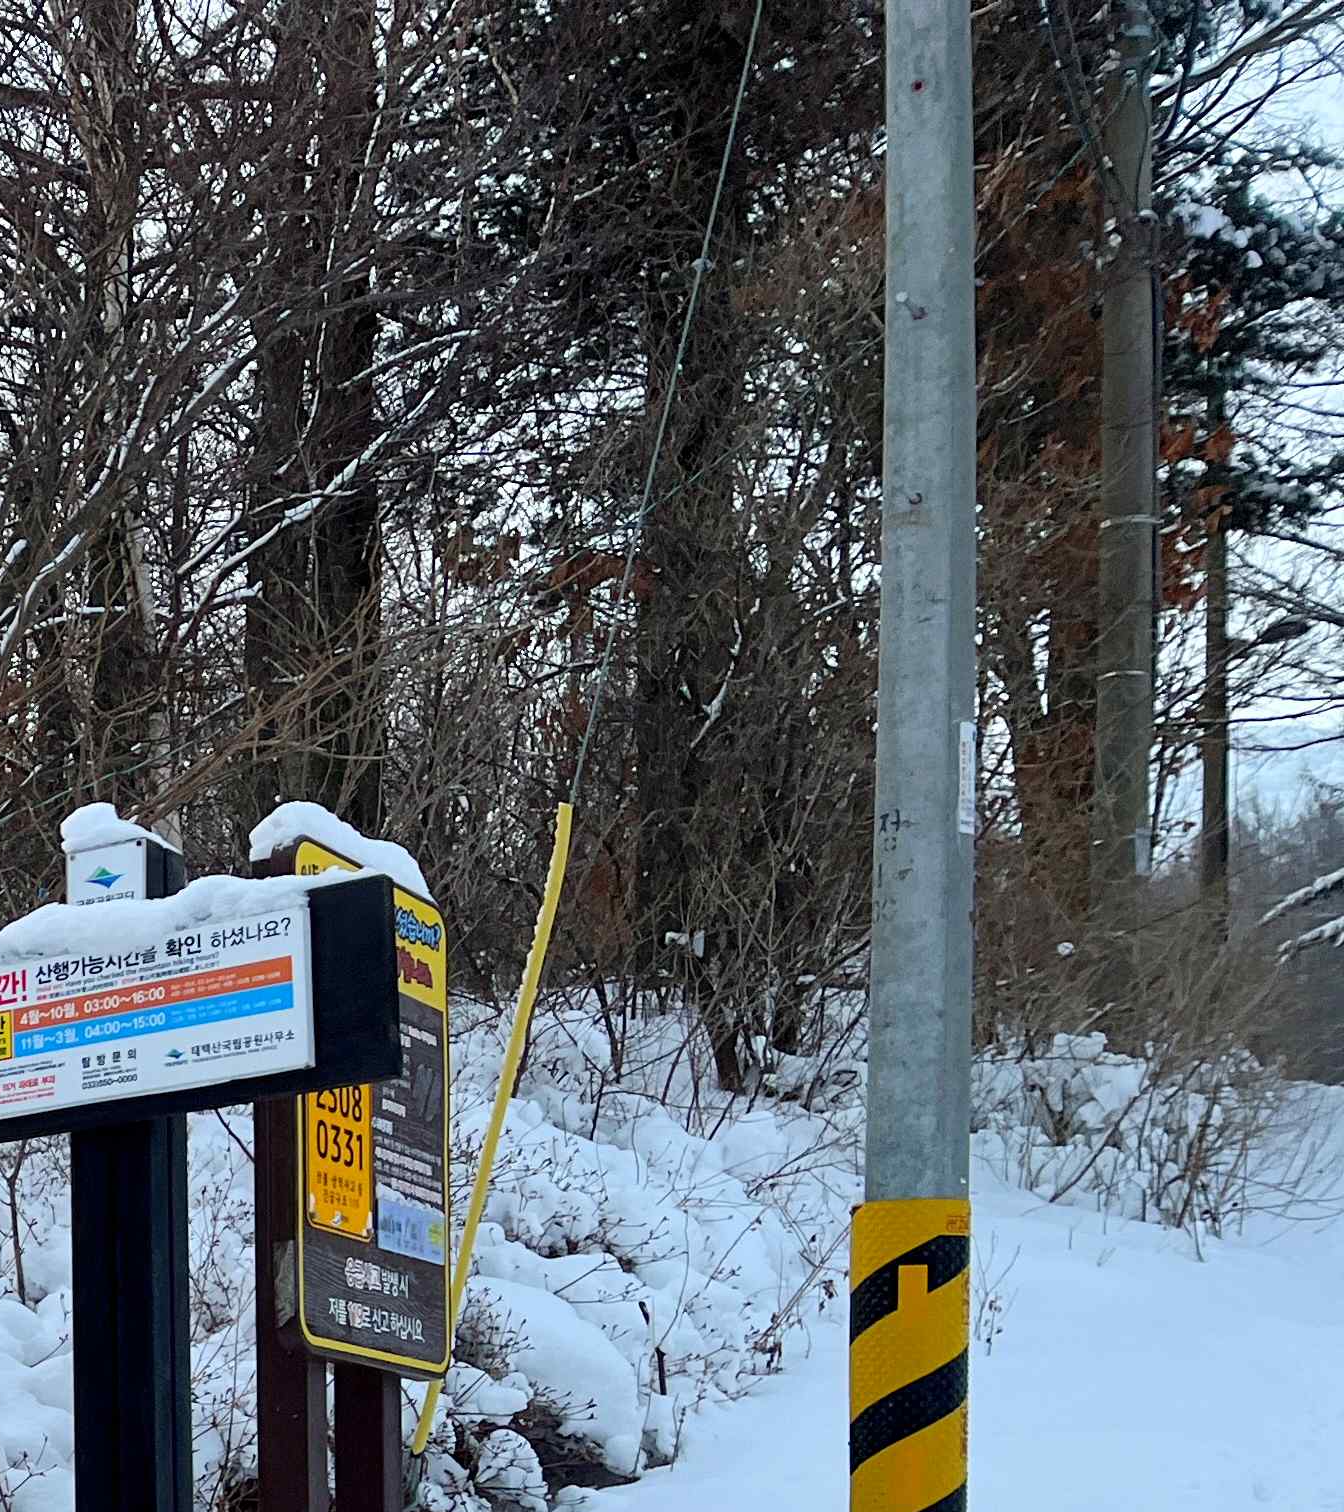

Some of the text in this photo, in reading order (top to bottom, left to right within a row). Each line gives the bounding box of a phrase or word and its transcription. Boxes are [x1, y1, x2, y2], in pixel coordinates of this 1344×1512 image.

[166, 933, 202, 957] 확인
[210, 917, 292, 948] 하셨나요?
[84, 986, 165, 1014] 03:00~16:00
[84, 1013, 166, 1040] 04:00~15:00
[316, 1119, 363, 1171] 0331
